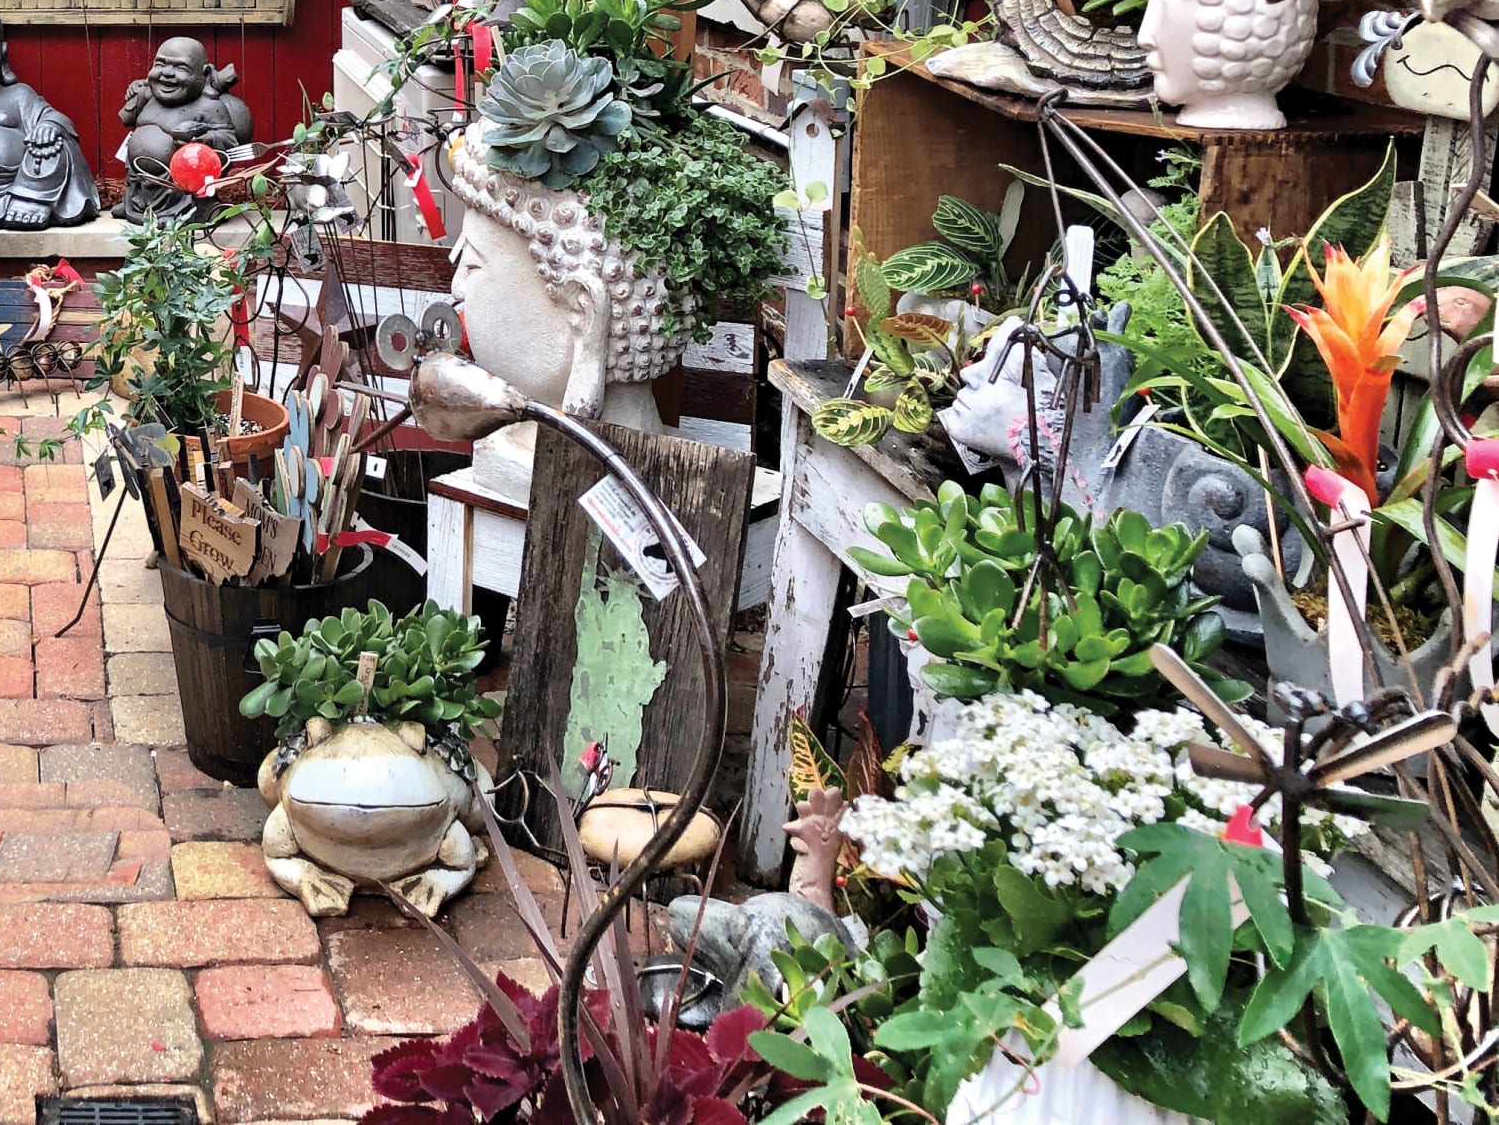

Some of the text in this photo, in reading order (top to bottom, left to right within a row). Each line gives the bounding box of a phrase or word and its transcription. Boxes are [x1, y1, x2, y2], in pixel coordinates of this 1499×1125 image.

[191, 498, 243, 545] Please
[244, 498, 279, 540] MOM'S
[189, 530, 235, 571] Grow
